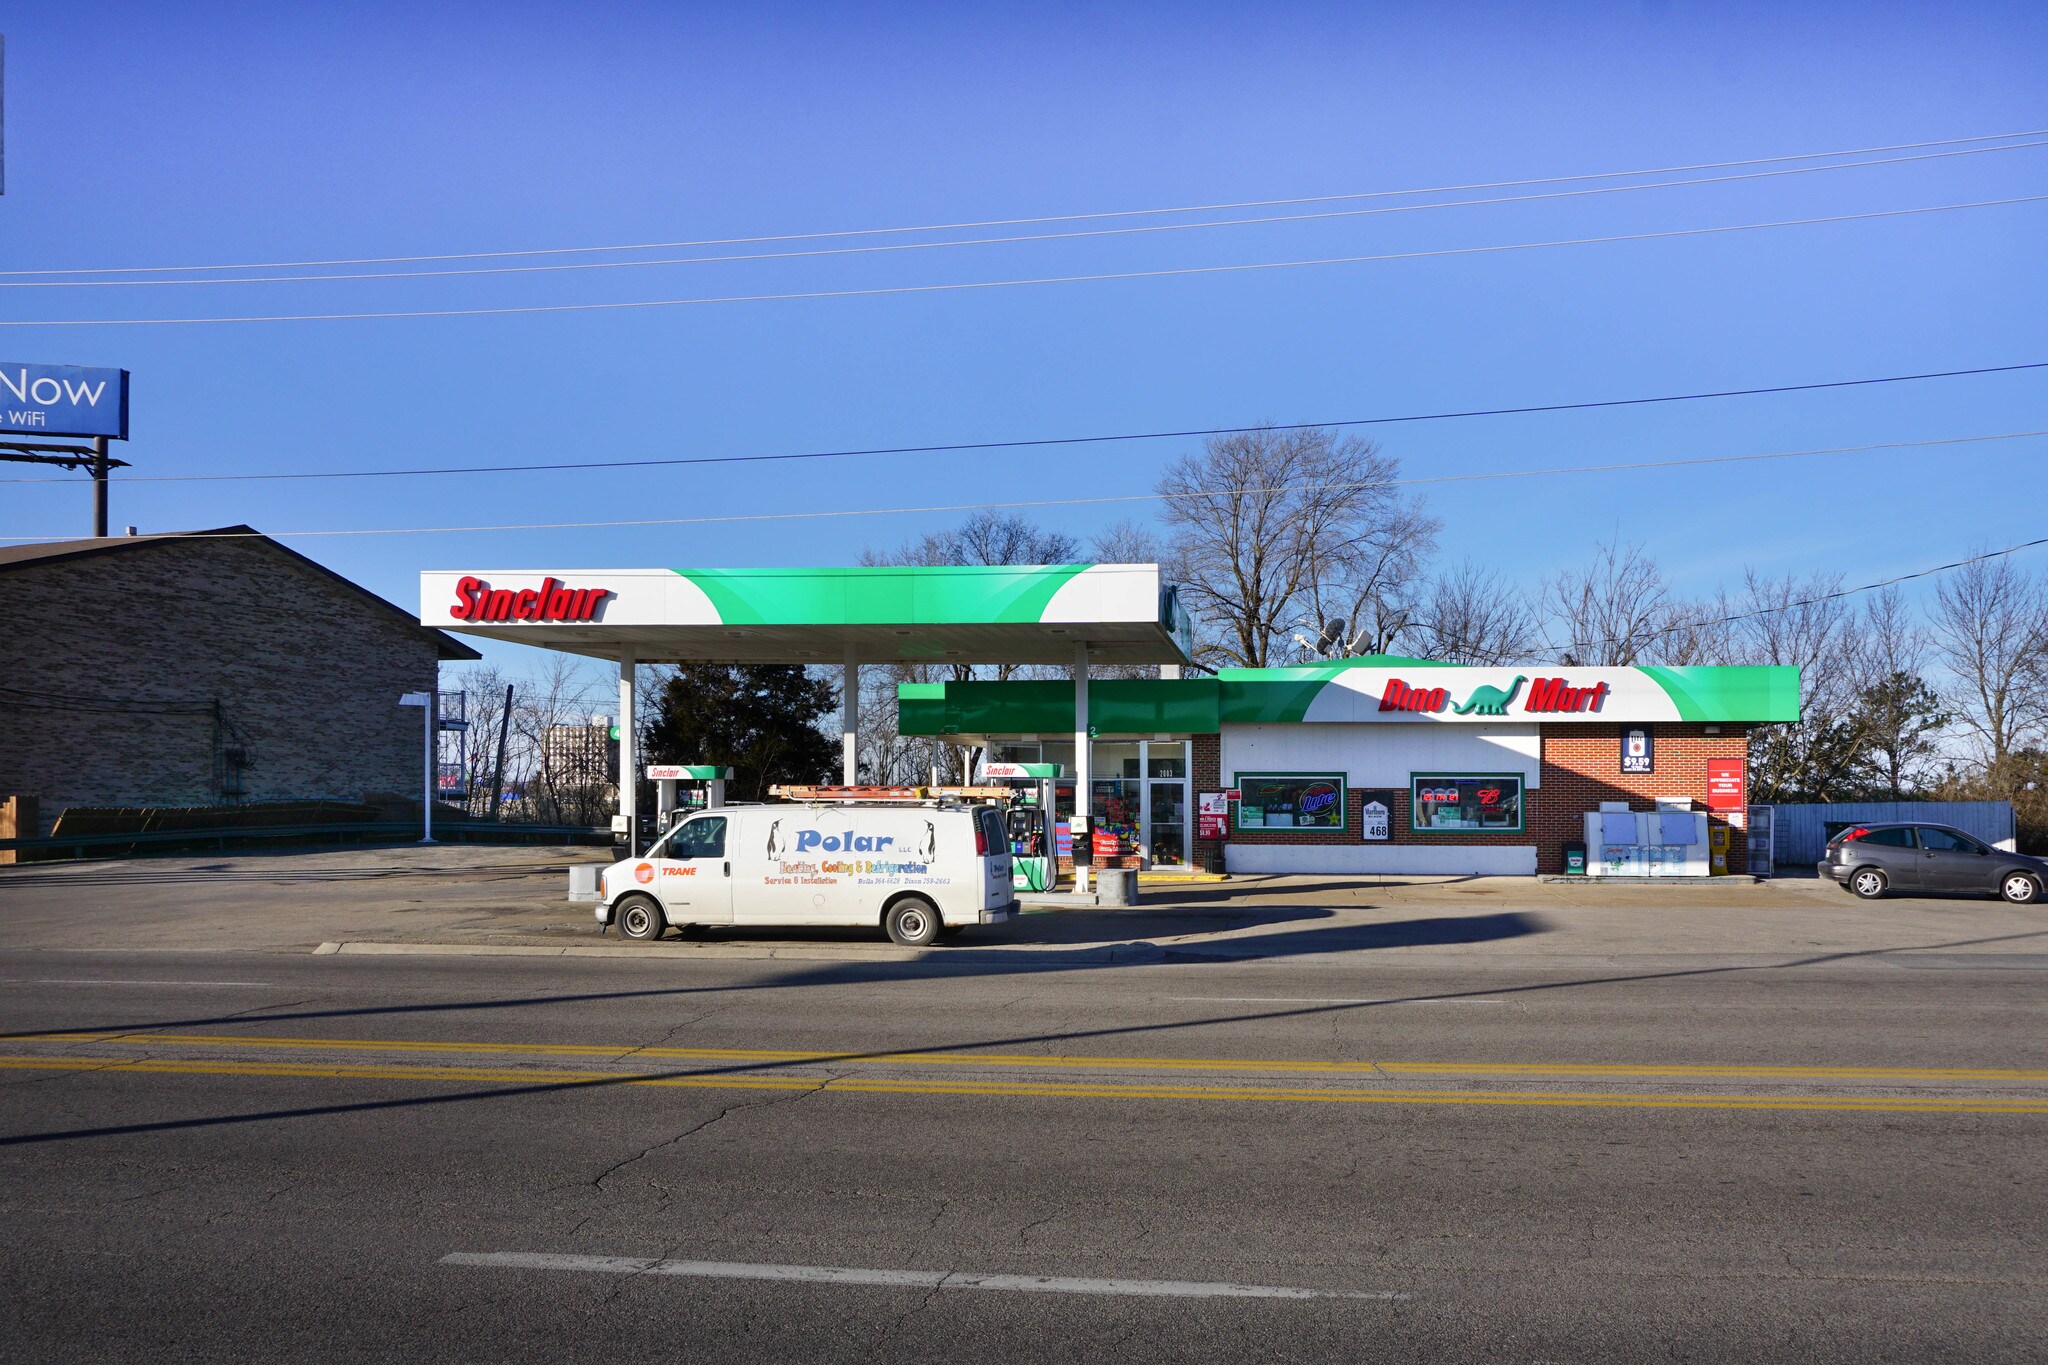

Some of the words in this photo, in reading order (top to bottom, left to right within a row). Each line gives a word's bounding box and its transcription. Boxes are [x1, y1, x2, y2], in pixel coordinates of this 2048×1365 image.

[8, 410, 45, 427] WiFi
[450, 576, 612, 622] Sinclair
[1378, 678, 1447, 713] Dino
[1524, 678, 1608, 713] Mart
[1090, 726, 1096, 735] 2
[1624, 757, 1650, 767] $9.59
[652, 767, 680, 778] Sinclair
[986, 765, 1016, 775] Sinclair
[1370, 826, 1387, 836] 468
[795, 829, 895, 852] Polar
[1628, 846, 1680, 873] ICE
[662, 867, 697, 876] TRANE
[780, 860, 818, 877] Heating,
[822, 860, 854, 877] Cooling
[855, 860, 863, 873] &
[865, 860, 928, 877] Refrigeration
[764, 876, 792, 885] Service
[800, 876, 838, 885] Installation
